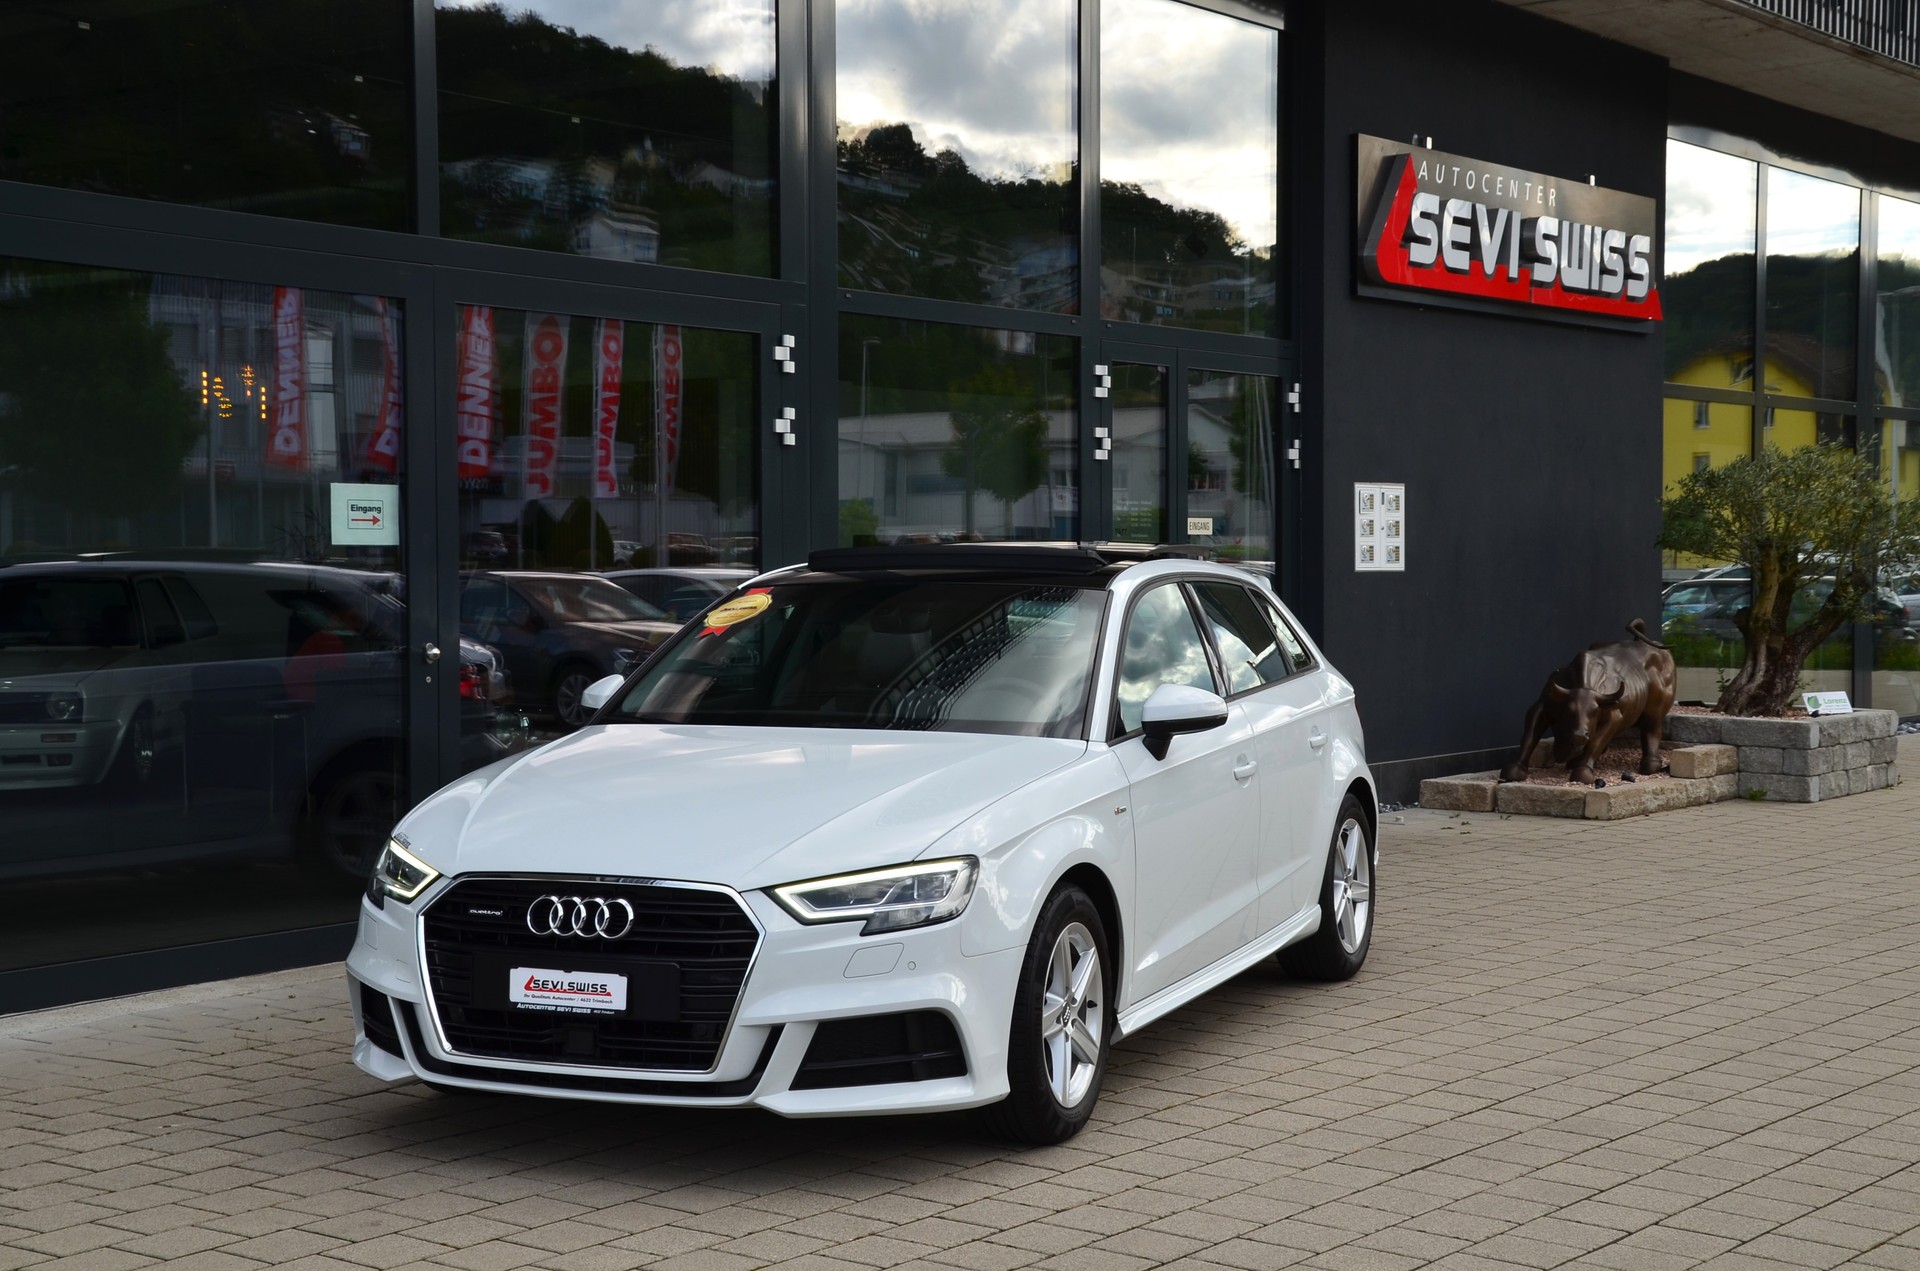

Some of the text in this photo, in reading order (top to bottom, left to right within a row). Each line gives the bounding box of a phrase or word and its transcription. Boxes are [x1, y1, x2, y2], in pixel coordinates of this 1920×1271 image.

[1418, 160, 1557, 207] AUTOCENTER
[1408, 192, 1651, 299] SEVI SWISS
[526, 331, 563, 494] JUMBO
[596, 334, 621, 493] JUMBO
[350, 504, 382, 514] Eingang
[1189, 521, 1210, 531] EINGANG
[532, 979, 608, 994] SEVI SWISS
